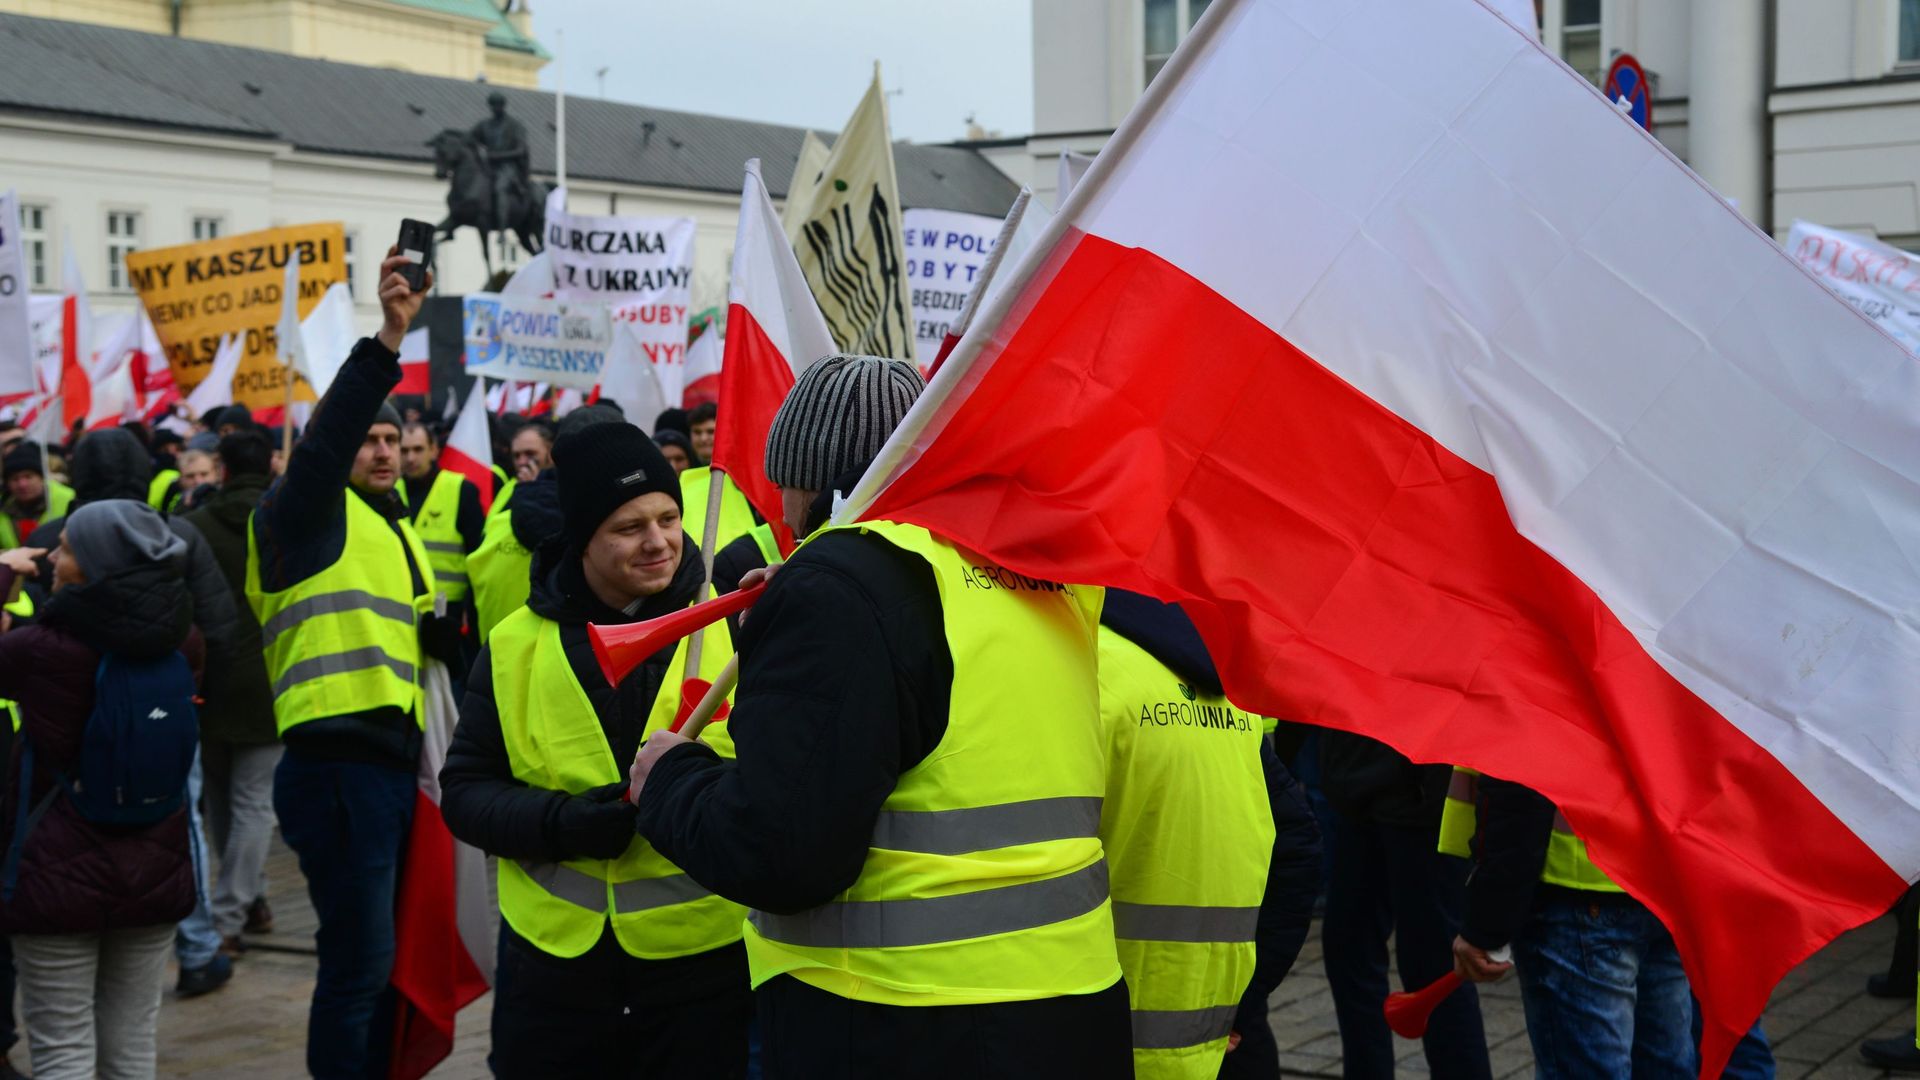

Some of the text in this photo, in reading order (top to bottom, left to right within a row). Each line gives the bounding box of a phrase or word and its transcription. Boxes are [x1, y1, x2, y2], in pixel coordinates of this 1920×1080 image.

[921, 230, 940, 247] W
[944, 232, 996, 255] POL
[129, 239, 330, 293] MY KASZUBI
[585, 266, 692, 291] UKRAINY
[202, 292, 234, 315] CO
[502, 309, 560, 338] POWIAT
